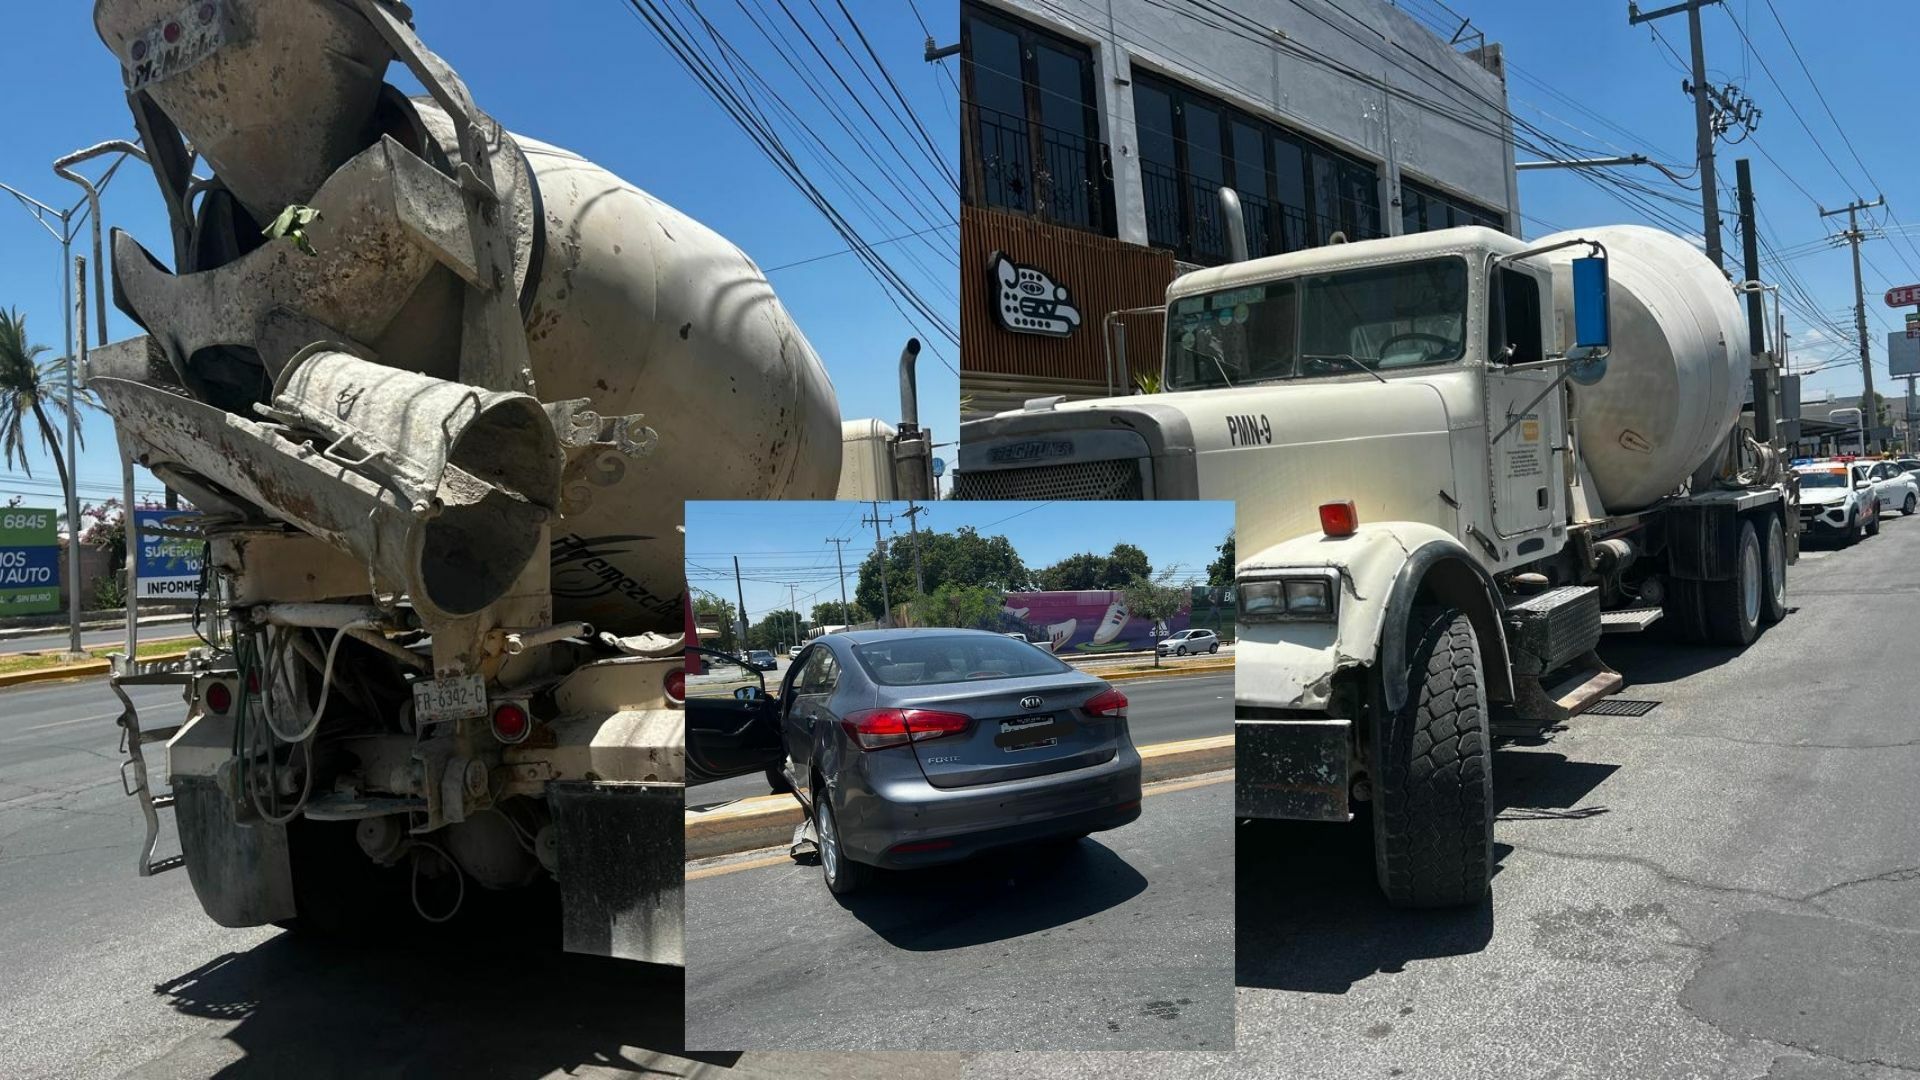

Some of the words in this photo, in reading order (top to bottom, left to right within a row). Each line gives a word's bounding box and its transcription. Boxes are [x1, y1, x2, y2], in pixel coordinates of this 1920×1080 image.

[1225, 414, 1272, 446] PMN-9
[4, 514, 47, 529] 6845
[5, 567, 51, 584] AUTO
[1024, 699, 1041, 709] KIA
[928, 755, 961, 765] FORTE
